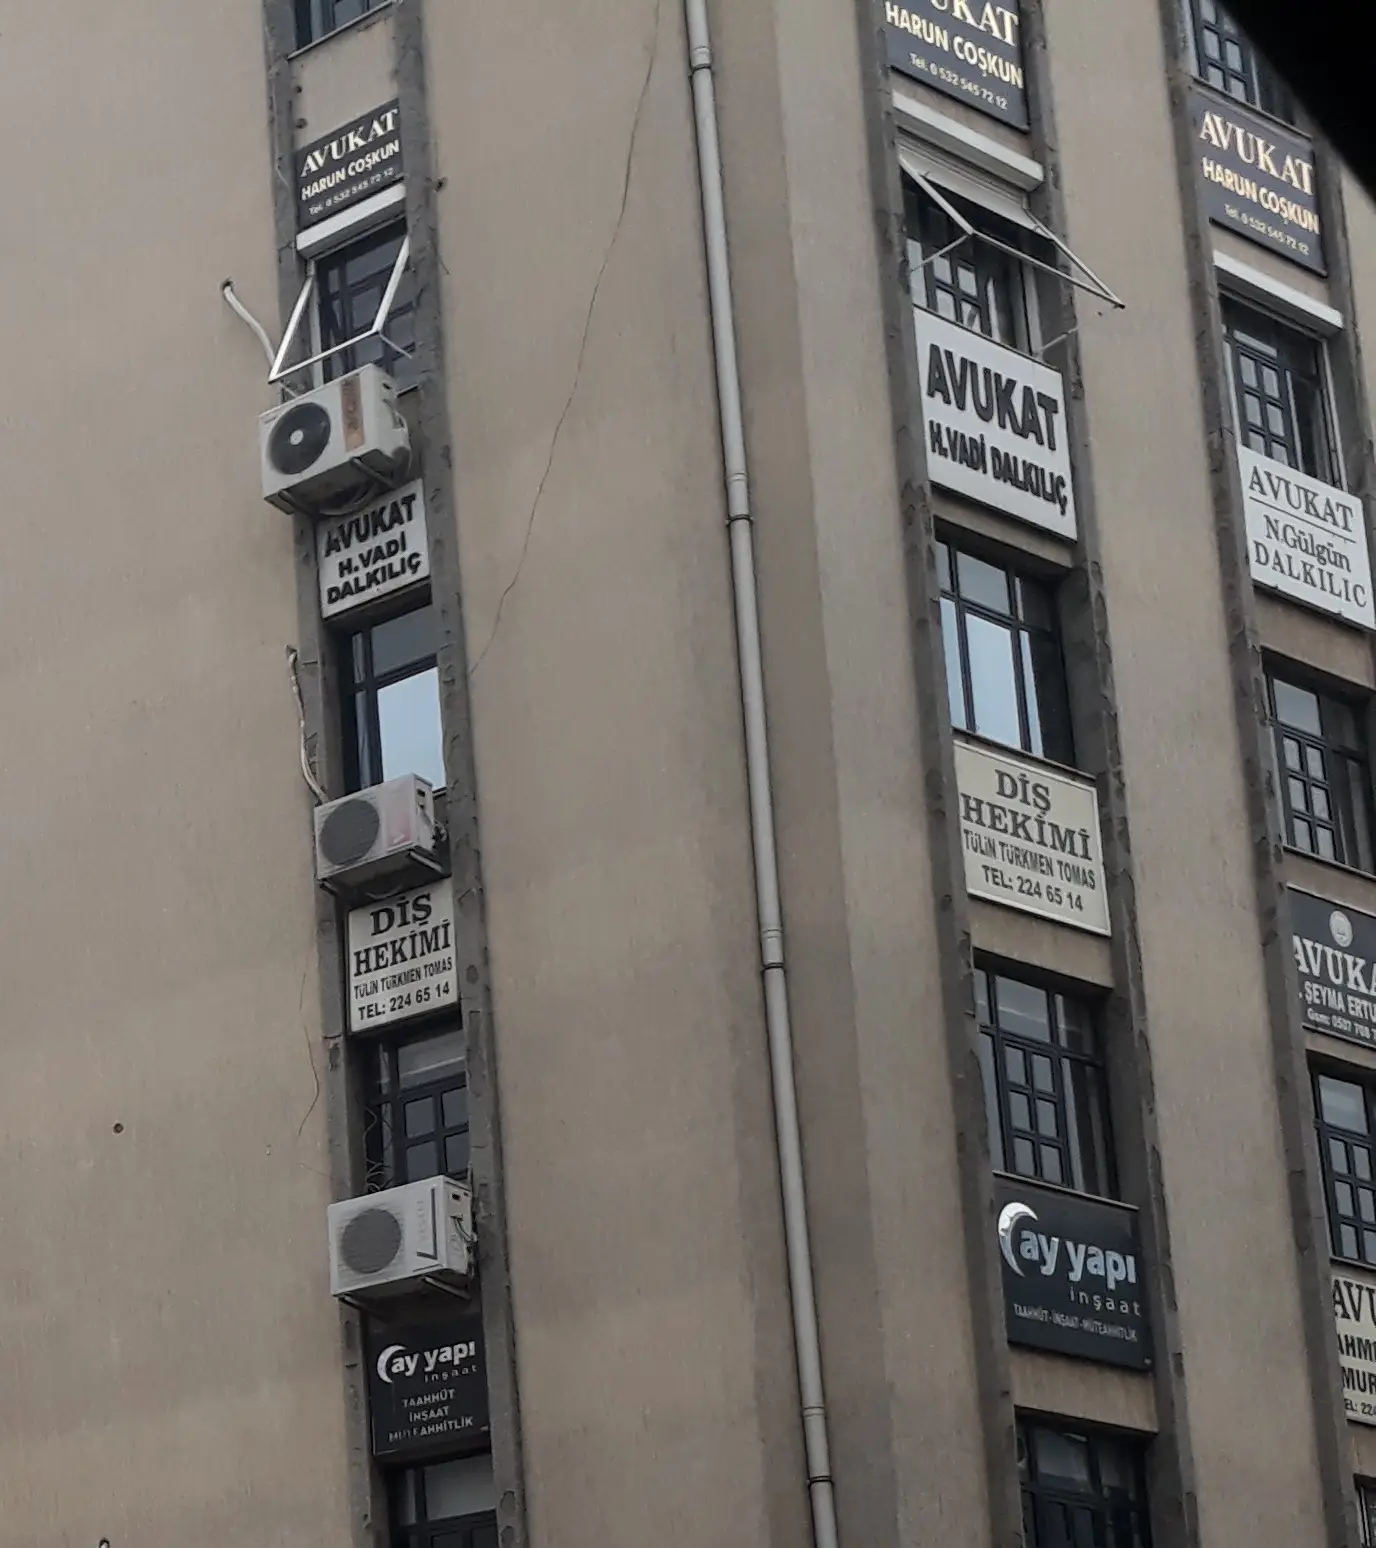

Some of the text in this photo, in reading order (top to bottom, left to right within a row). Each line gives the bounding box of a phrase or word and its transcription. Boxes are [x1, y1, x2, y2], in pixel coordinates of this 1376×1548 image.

[884, 1, 1024, 89] HARUN COŞKUN
[299, 108, 399, 178] AVUKAT
[301, 140, 400, 201] HARUN COŞKUN
[1199, 110, 1314, 196] AVUKAT
[1201, 156, 1320, 235] HARUN COŞKUN
[926, 342, 1059, 452] AVUKAT
[989, 445, 1068, 517] DALKILIÇ
[1248, 464, 1354, 533] AVUKAT
[324, 492, 417, 558] AVUKAT
[959, 792, 1093, 861] HEKİMİ
[369, 892, 432, 937] DİŞ
[981, 864, 1084, 912] TEL: 224 65 14
[353, 918, 451, 978] HEKİMİ
[358, 980, 451, 1021] TEL: 224 65 14
[1019, 1229, 1137, 1291] ay yapı
[390, 1340, 476, 1377] ay yapı
